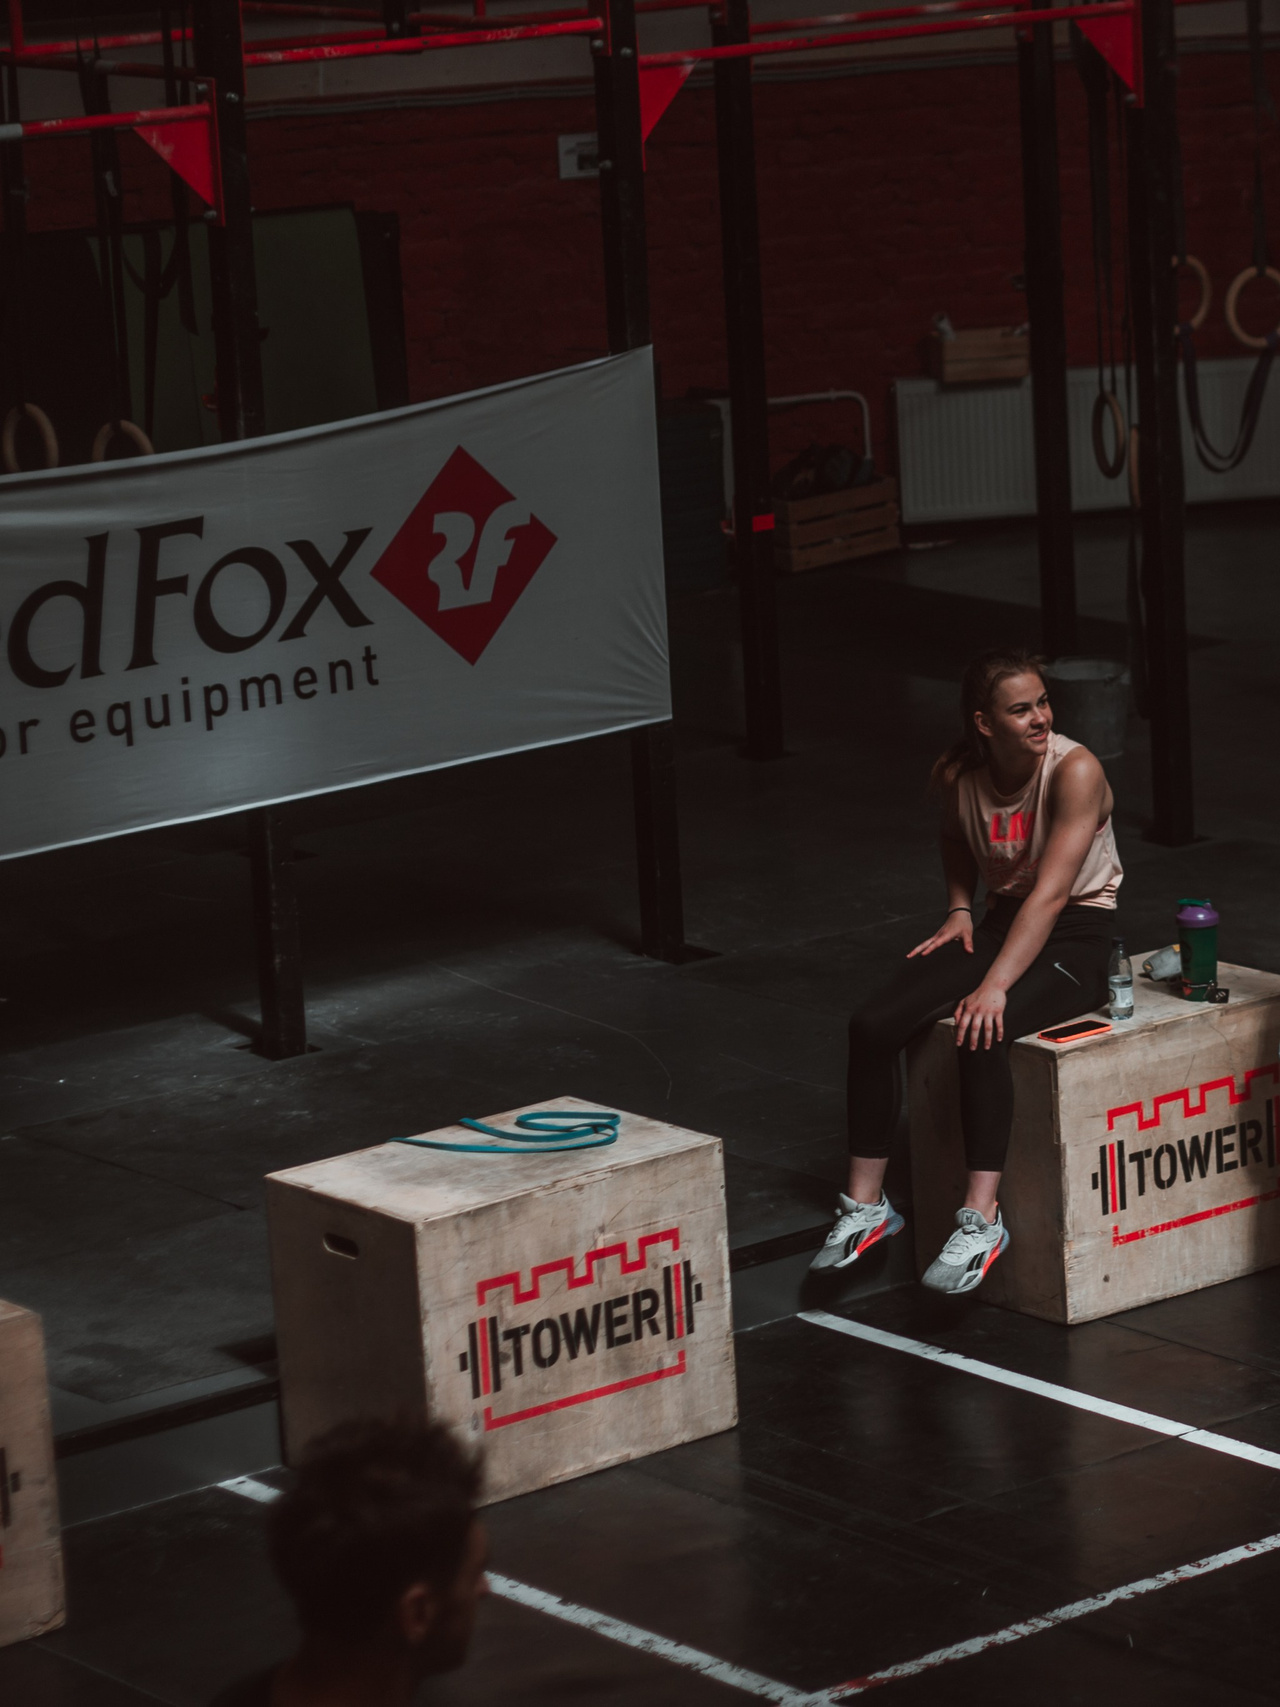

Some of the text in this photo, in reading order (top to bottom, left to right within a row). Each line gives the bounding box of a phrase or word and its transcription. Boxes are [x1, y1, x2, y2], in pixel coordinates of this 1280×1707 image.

[69, 645, 380, 746] equipment
[1128, 1119, 1264, 1197] TOWER
[502, 1287, 662, 1378] TOWER
